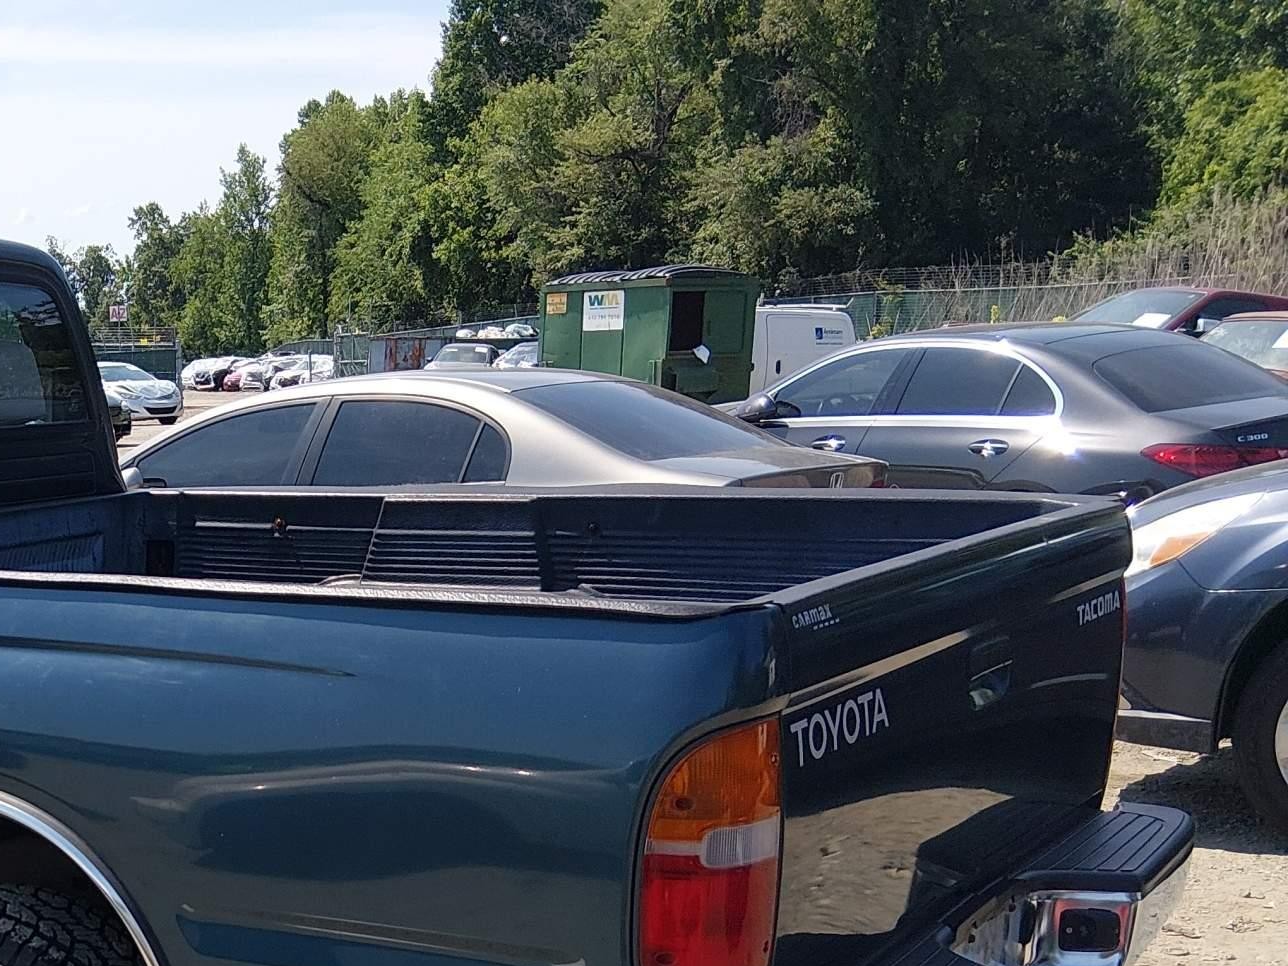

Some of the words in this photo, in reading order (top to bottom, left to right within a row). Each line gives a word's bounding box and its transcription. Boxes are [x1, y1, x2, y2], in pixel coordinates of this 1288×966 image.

[1246, 433, 1269, 442] 300
[1076, 589, 1121, 626] TACOMA
[790, 688, 890, 768] TOYOTA
